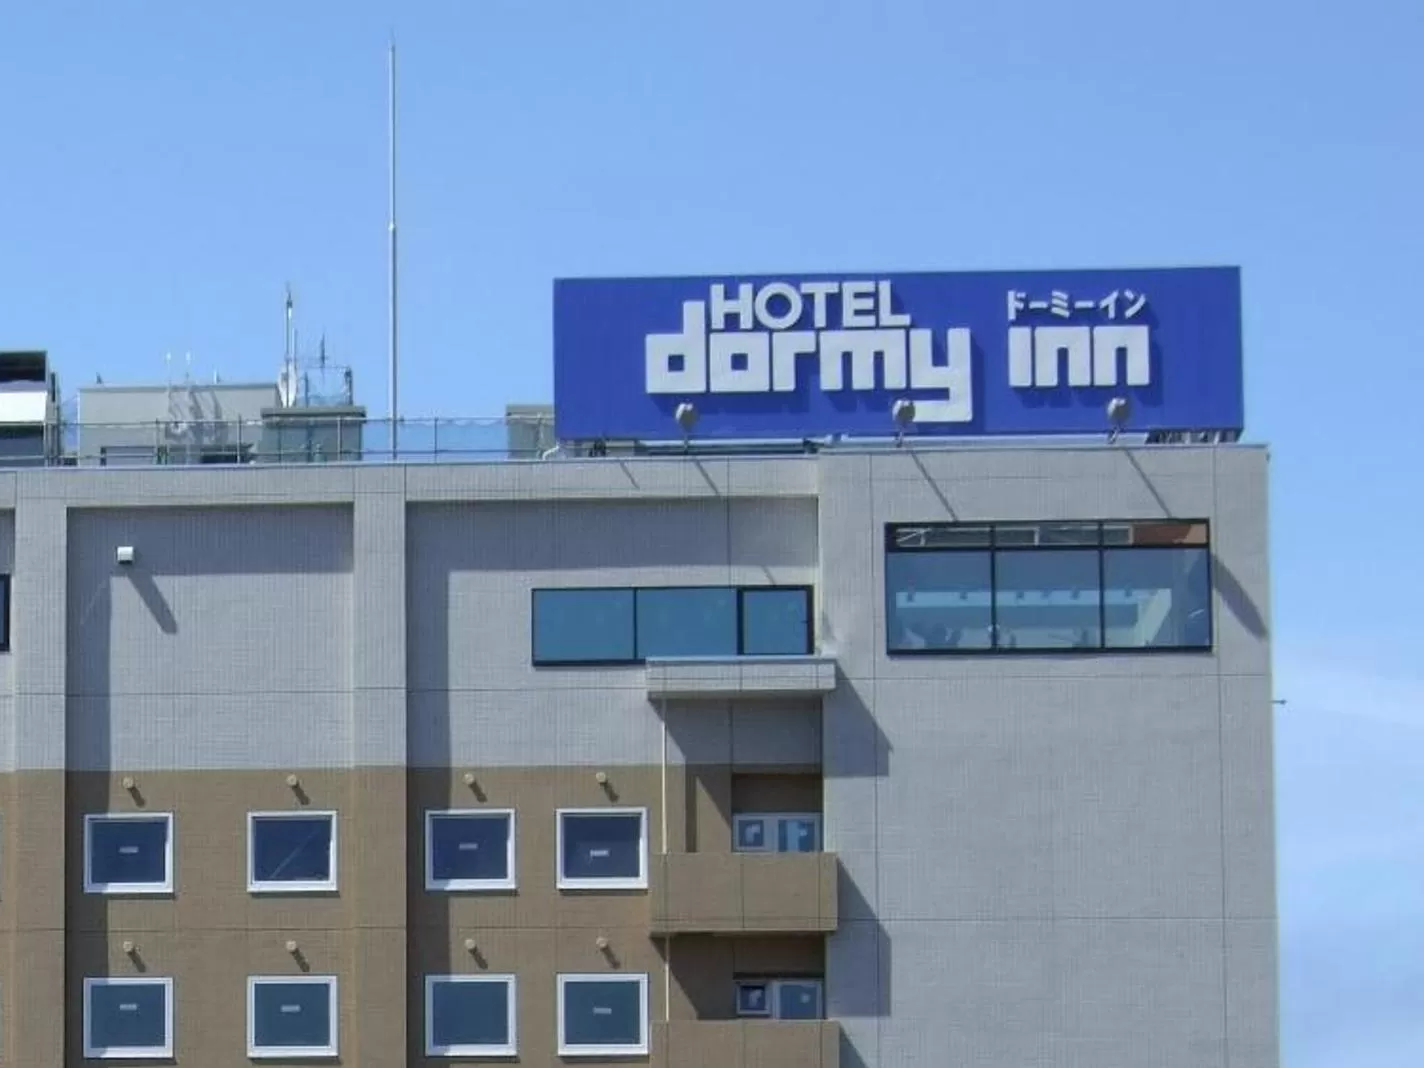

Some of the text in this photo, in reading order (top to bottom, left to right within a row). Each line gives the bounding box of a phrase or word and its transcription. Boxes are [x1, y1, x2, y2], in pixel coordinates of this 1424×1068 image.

[710, 280, 911, 329] HOTEL
[1007, 289, 1146, 321] ドーミーイン
[645, 300, 1150, 422] dormy inn
